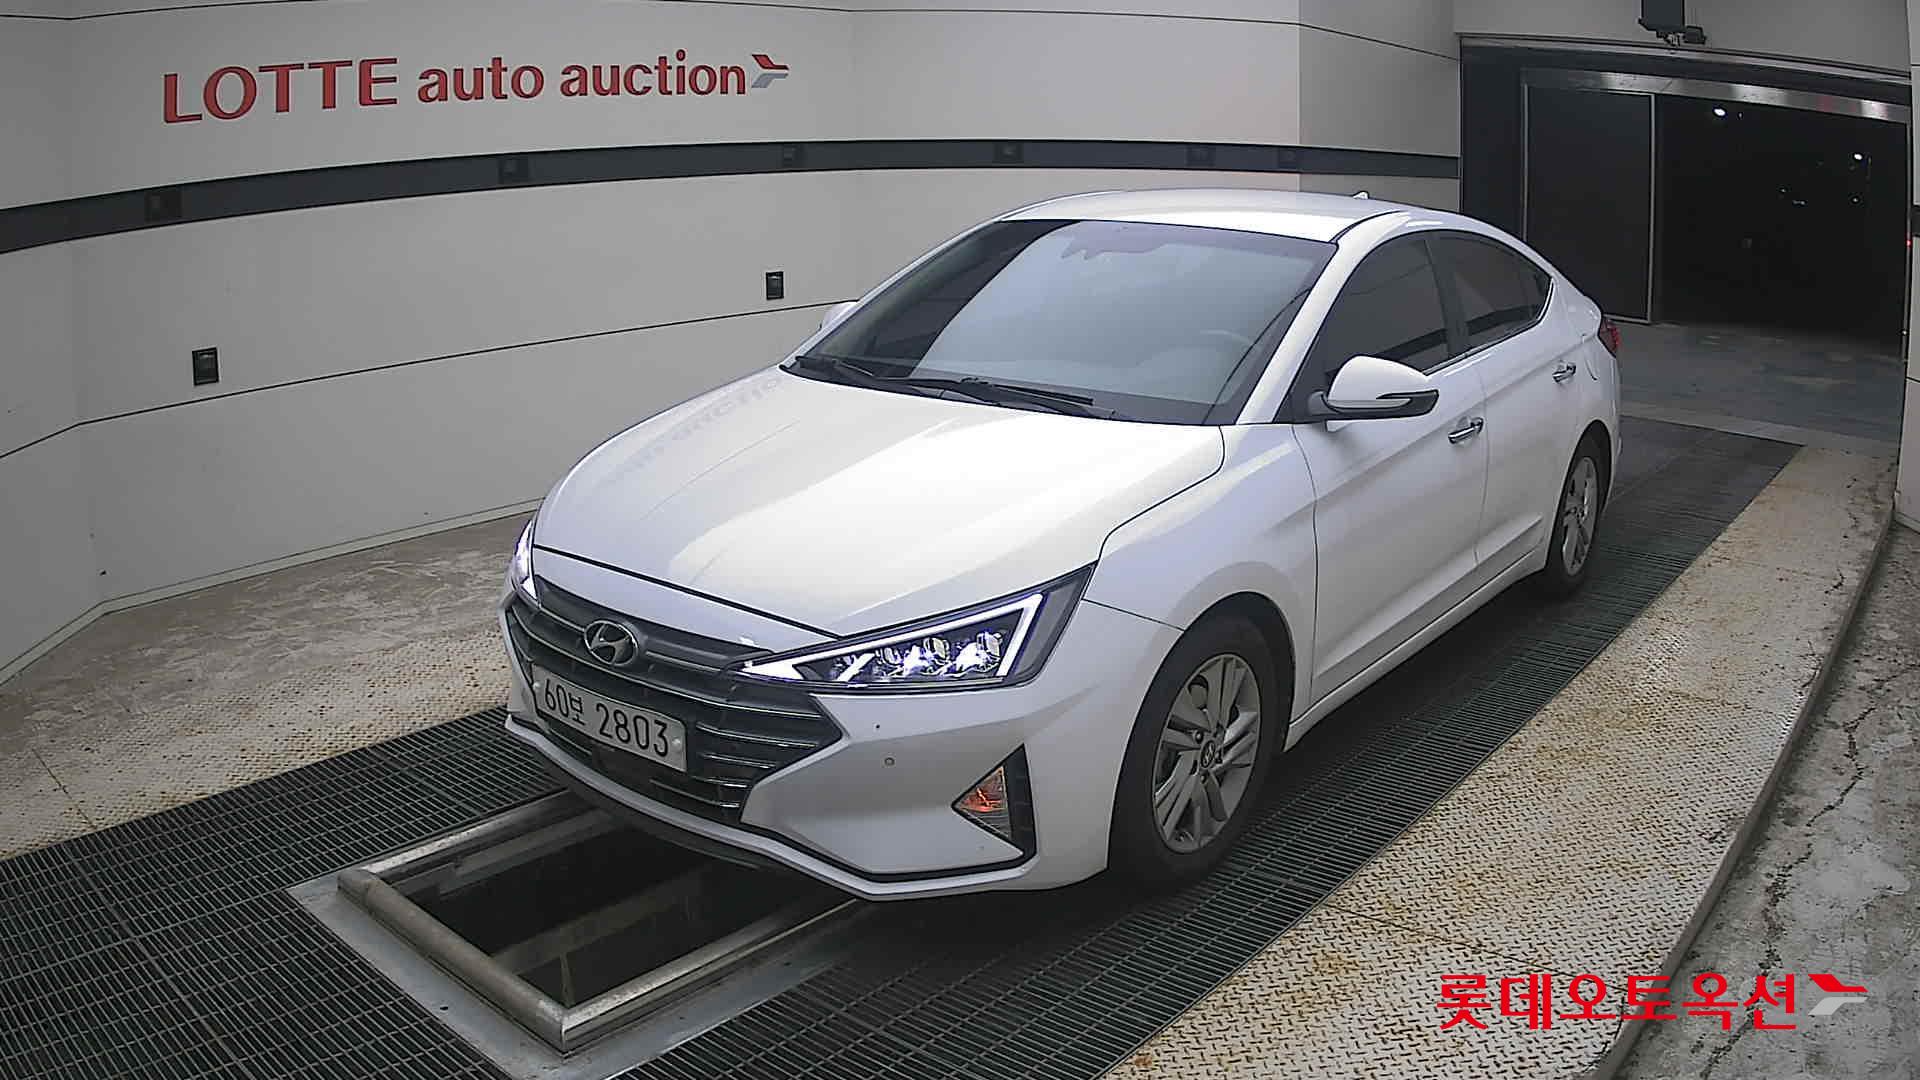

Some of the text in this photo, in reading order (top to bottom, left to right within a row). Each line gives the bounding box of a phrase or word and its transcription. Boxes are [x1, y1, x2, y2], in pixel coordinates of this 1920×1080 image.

[163, 50, 747, 124] LOTTE auto auction
[544, 679, 668, 757] 60보 2803
